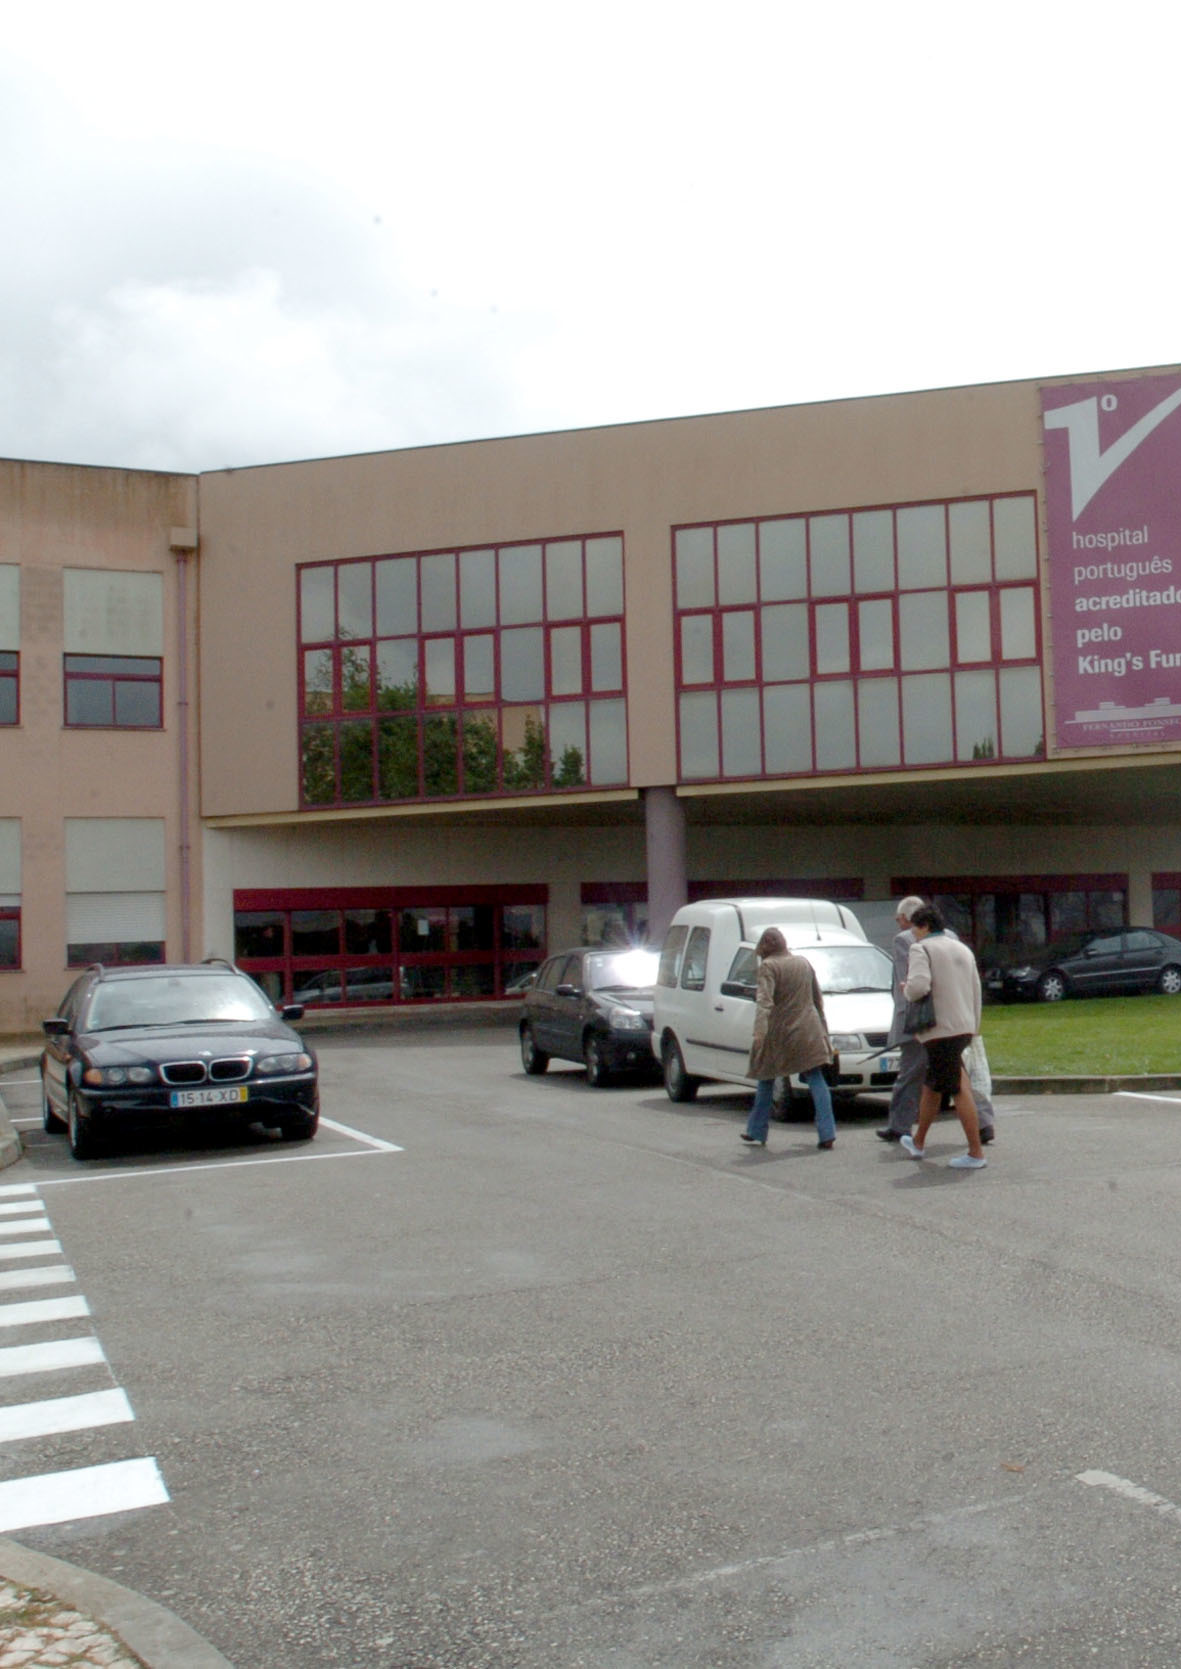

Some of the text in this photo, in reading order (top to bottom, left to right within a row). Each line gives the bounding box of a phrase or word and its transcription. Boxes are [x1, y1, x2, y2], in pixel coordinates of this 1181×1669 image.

[1072, 525, 1148, 551] hospital
[1074, 556, 1172, 584] português
[1077, 622, 1122, 648] pelo
[1078, 652, 1143, 676] King's
